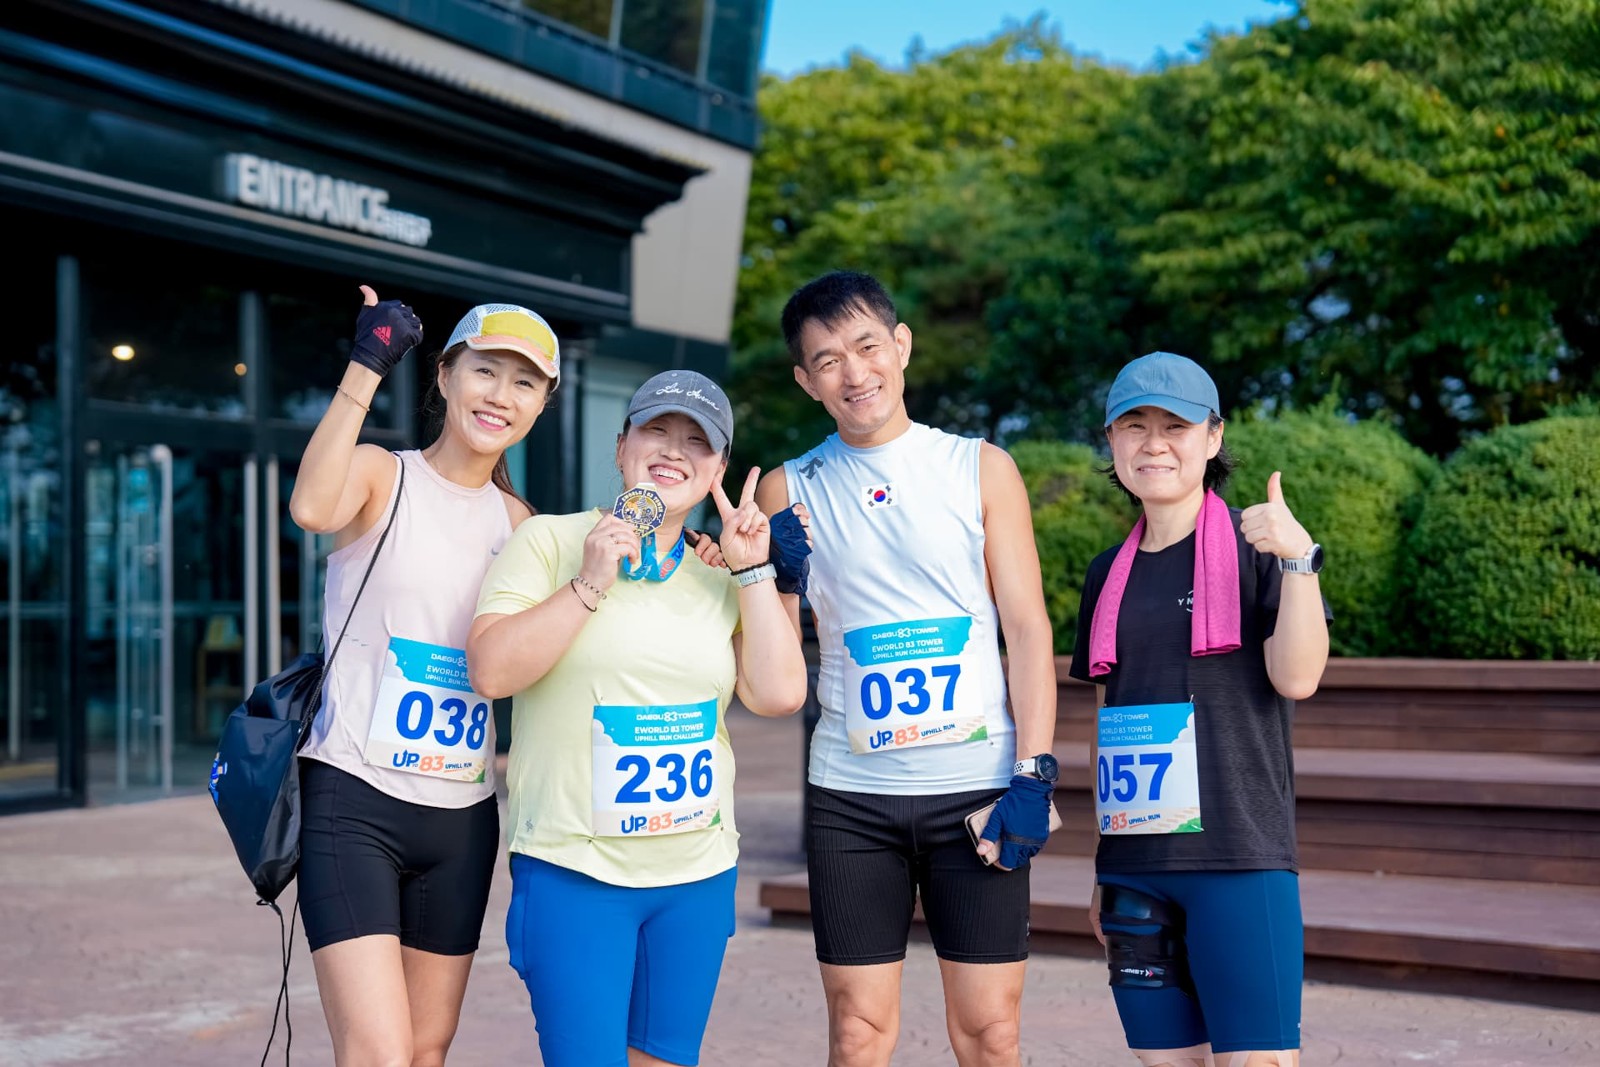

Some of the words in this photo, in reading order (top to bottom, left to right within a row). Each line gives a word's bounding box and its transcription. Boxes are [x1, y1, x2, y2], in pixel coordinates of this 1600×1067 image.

[228, 153, 389, 237] ENTRANCE
[872, 642, 904, 652] EWORLD
[916, 638, 943, 647] TOWER
[908, 646, 944, 655] CHALLENGE
[424, 674, 448, 684] UPHILL
[426, 664, 460, 677] EWORLD
[860, 664, 962, 720] 037
[396, 690, 488, 750] 038
[634, 726, 669, 734] EWORLD
[680, 723, 704, 732] TOWER
[1126, 725, 1152, 733] TOWER
[672, 731, 704, 740] CHALLENGE
[870, 730, 893, 749] UP
[894, 725, 920, 746] 83
[921, 728, 942, 736] UPHILL
[1121, 733, 1153, 741] CHALLENGE
[392, 749, 420, 768] UP
[419, 756, 445, 772] 83
[614, 748, 713, 804] 236
[1098, 752, 1172, 803] 057
[622, 814, 647, 834] UP
[649, 812, 672, 832] 83
[674, 814, 692, 824] UPHILL
[1100, 814, 1110, 831] UP
[1111, 812, 1128, 831] 83
[1128, 816, 1148, 825] UPHILL
